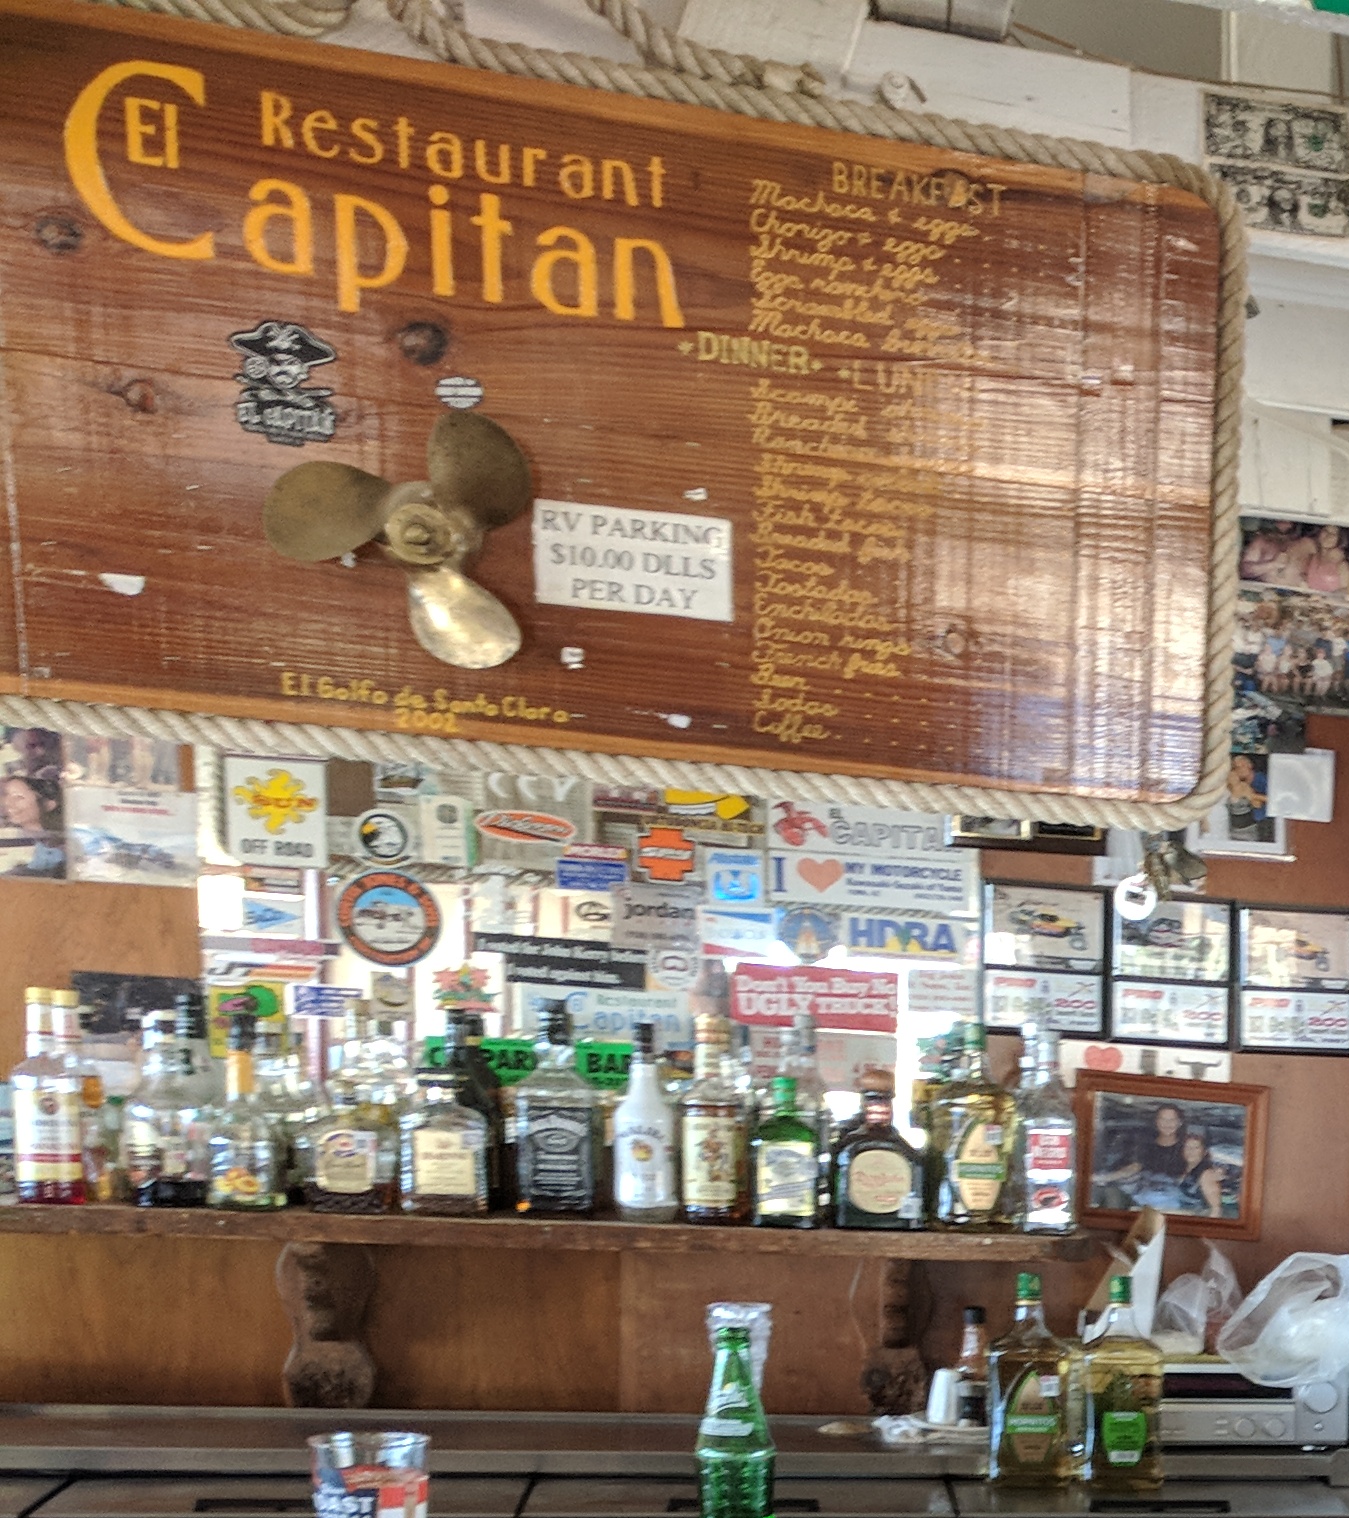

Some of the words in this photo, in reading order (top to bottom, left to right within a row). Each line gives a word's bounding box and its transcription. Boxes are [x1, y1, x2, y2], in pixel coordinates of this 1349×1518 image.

[124, 96, 180, 169] El
[259, 90, 668, 208] Restaurant
[64, 59, 686, 328] Capitan
[750, 207, 853, 252] Chorizo
[698, 331, 812, 375] DINNER
[540, 509, 583, 532] RV
[591, 515, 724, 548] PARKING
[551, 543, 636, 572] $10.00
[642, 552, 717, 580] DLLS
[754, 546, 836, 577] Tacos
[571, 578, 626, 603] PER
[634, 584, 698, 610] DAY
[754, 570, 879, 604] Tostadas
[754, 592, 900, 631] Enchiladas
[755, 617, 830, 646] Onion
[751, 641, 843, 669] French
[281, 671, 309, 697] El
[316, 673, 388, 705] Golfo
[394, 686, 428, 711] de
[397, 711, 460, 734] 2002
[754, 710, 832, 743] Coffee
[241, 838, 267, 855] OFF
[274, 841, 314, 858] ROAD
[829, 819, 963, 852] CAPITA
[773, 856, 786, 893] I
[845, 862, 865, 875] MY
[871, 863, 962, 882] MOTORCYCLE
[851, 917, 957, 951] HDRA
[735, 975, 790, 994] Don't
[794, 976, 830, 994] You
[830, 978, 869, 997] Buy
[737, 993, 815, 1016] UGLY
[816, 997, 898, 1018] TRUCK!
